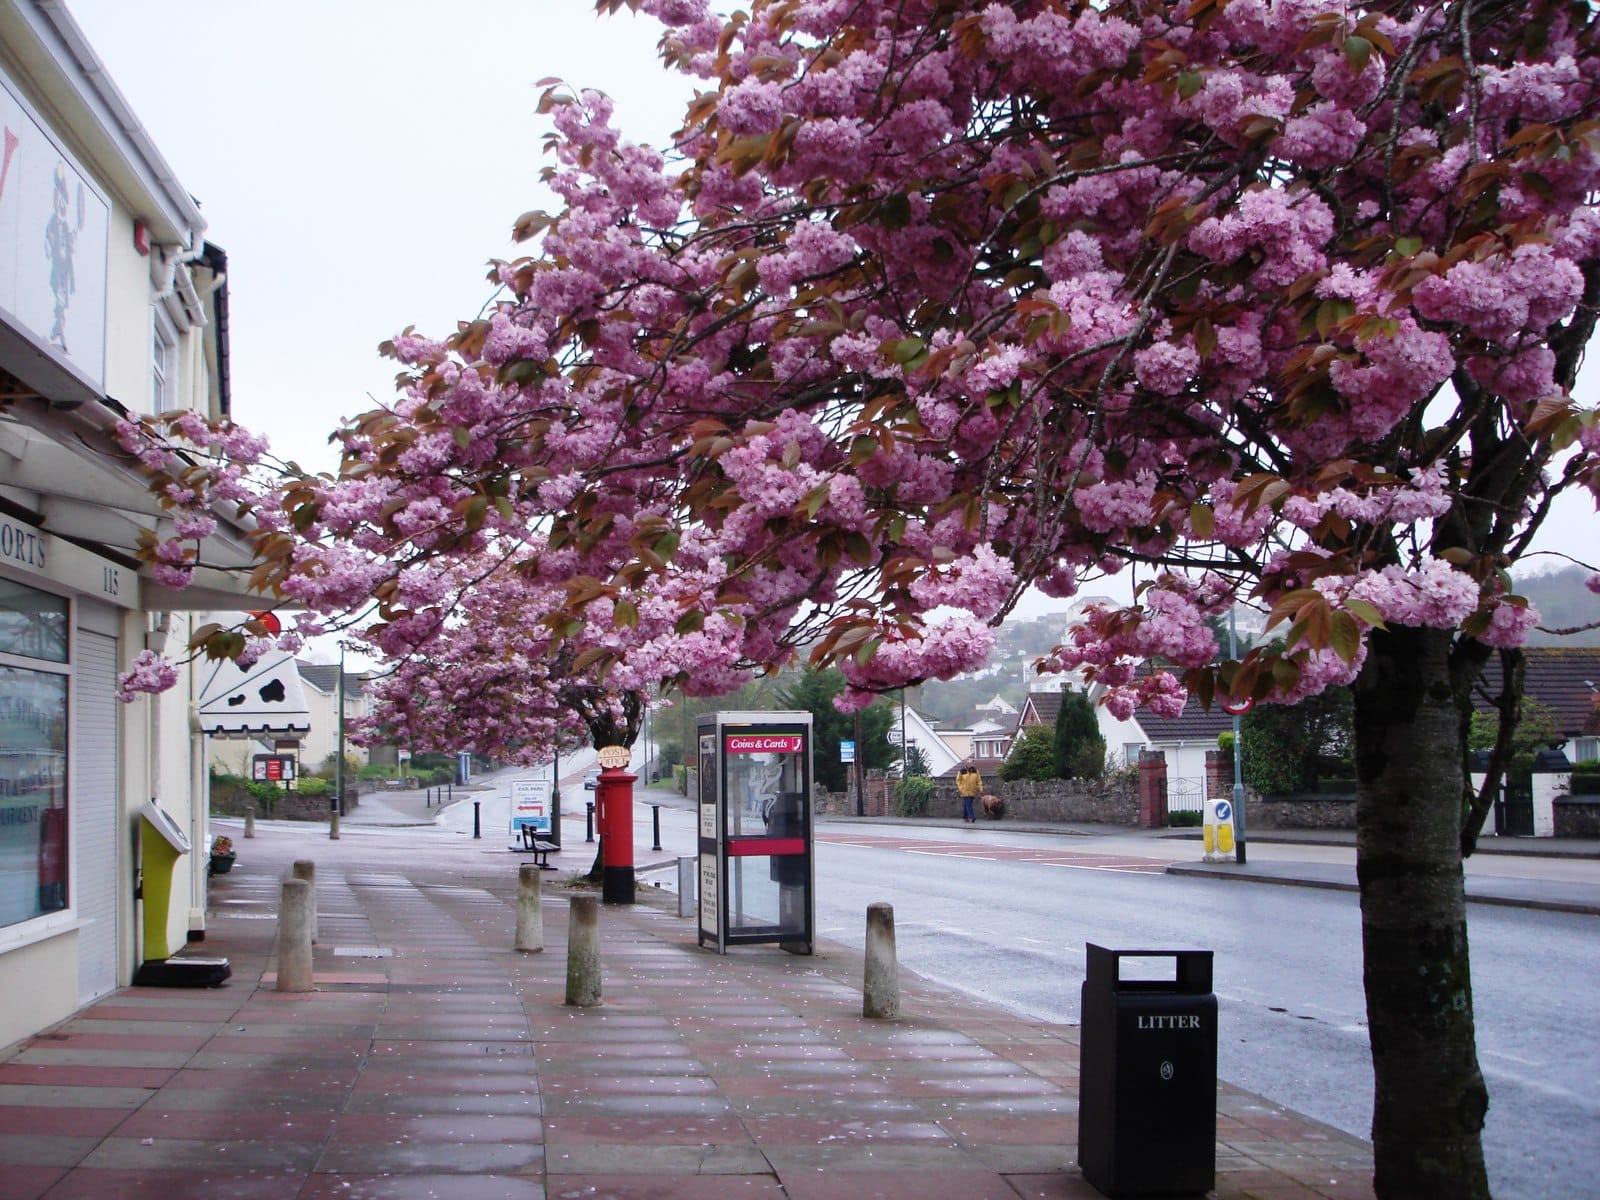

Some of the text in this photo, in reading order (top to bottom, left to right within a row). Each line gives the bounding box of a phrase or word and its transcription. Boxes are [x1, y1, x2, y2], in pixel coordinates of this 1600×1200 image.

[1, 523, 119, 596] ORTS 115
[730, 738, 788, 749] Coins & Cards
[603, 748, 624, 756] POST
[1137, 1015, 1201, 1029] LITTER
